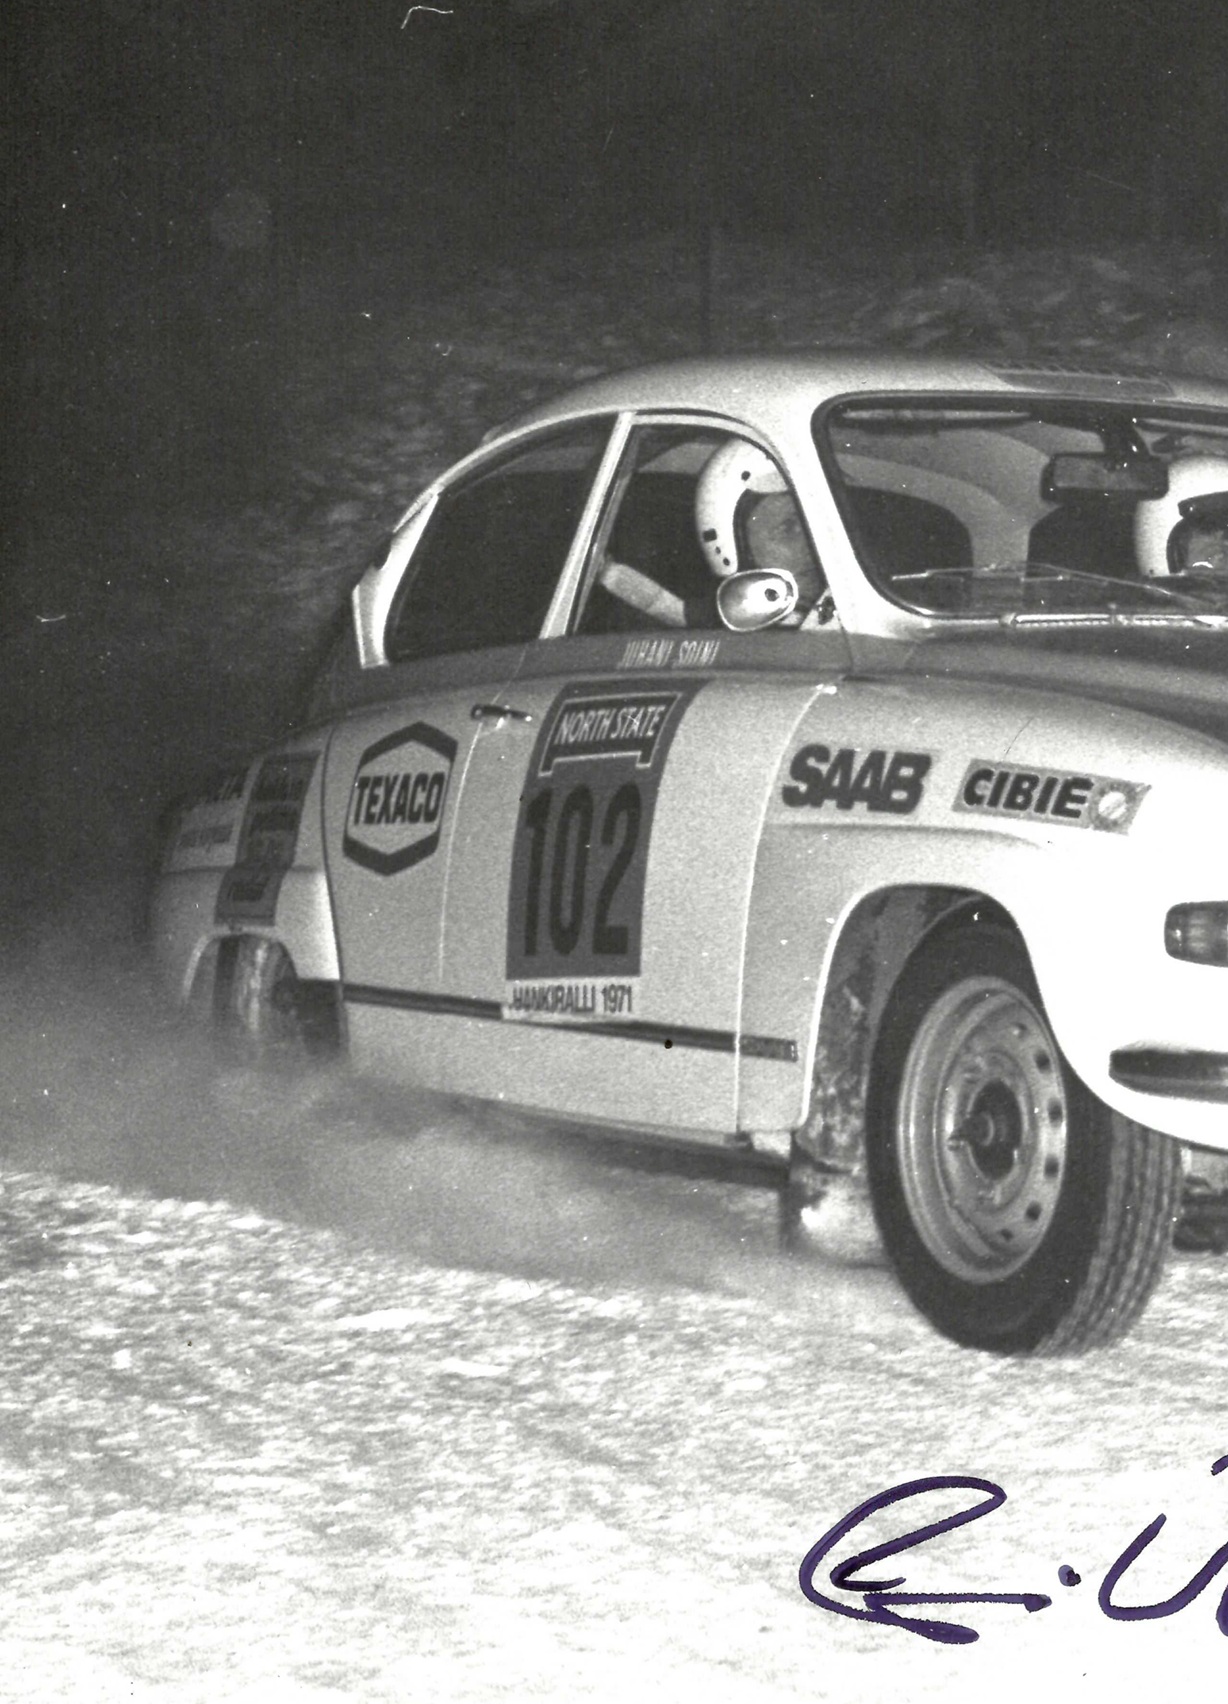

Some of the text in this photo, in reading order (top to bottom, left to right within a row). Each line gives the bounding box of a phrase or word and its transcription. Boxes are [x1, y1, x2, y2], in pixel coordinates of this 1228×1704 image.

[551, 702, 667, 745] NORTH STATE
[353, 771, 446, 826] TEXACO
[782, 744, 932, 814] SAAB
[963, 768, 1095, 819] CIBIE
[523, 779, 643, 957] 102
[511, 983, 633, 1014] HANKIRALLI 1971
